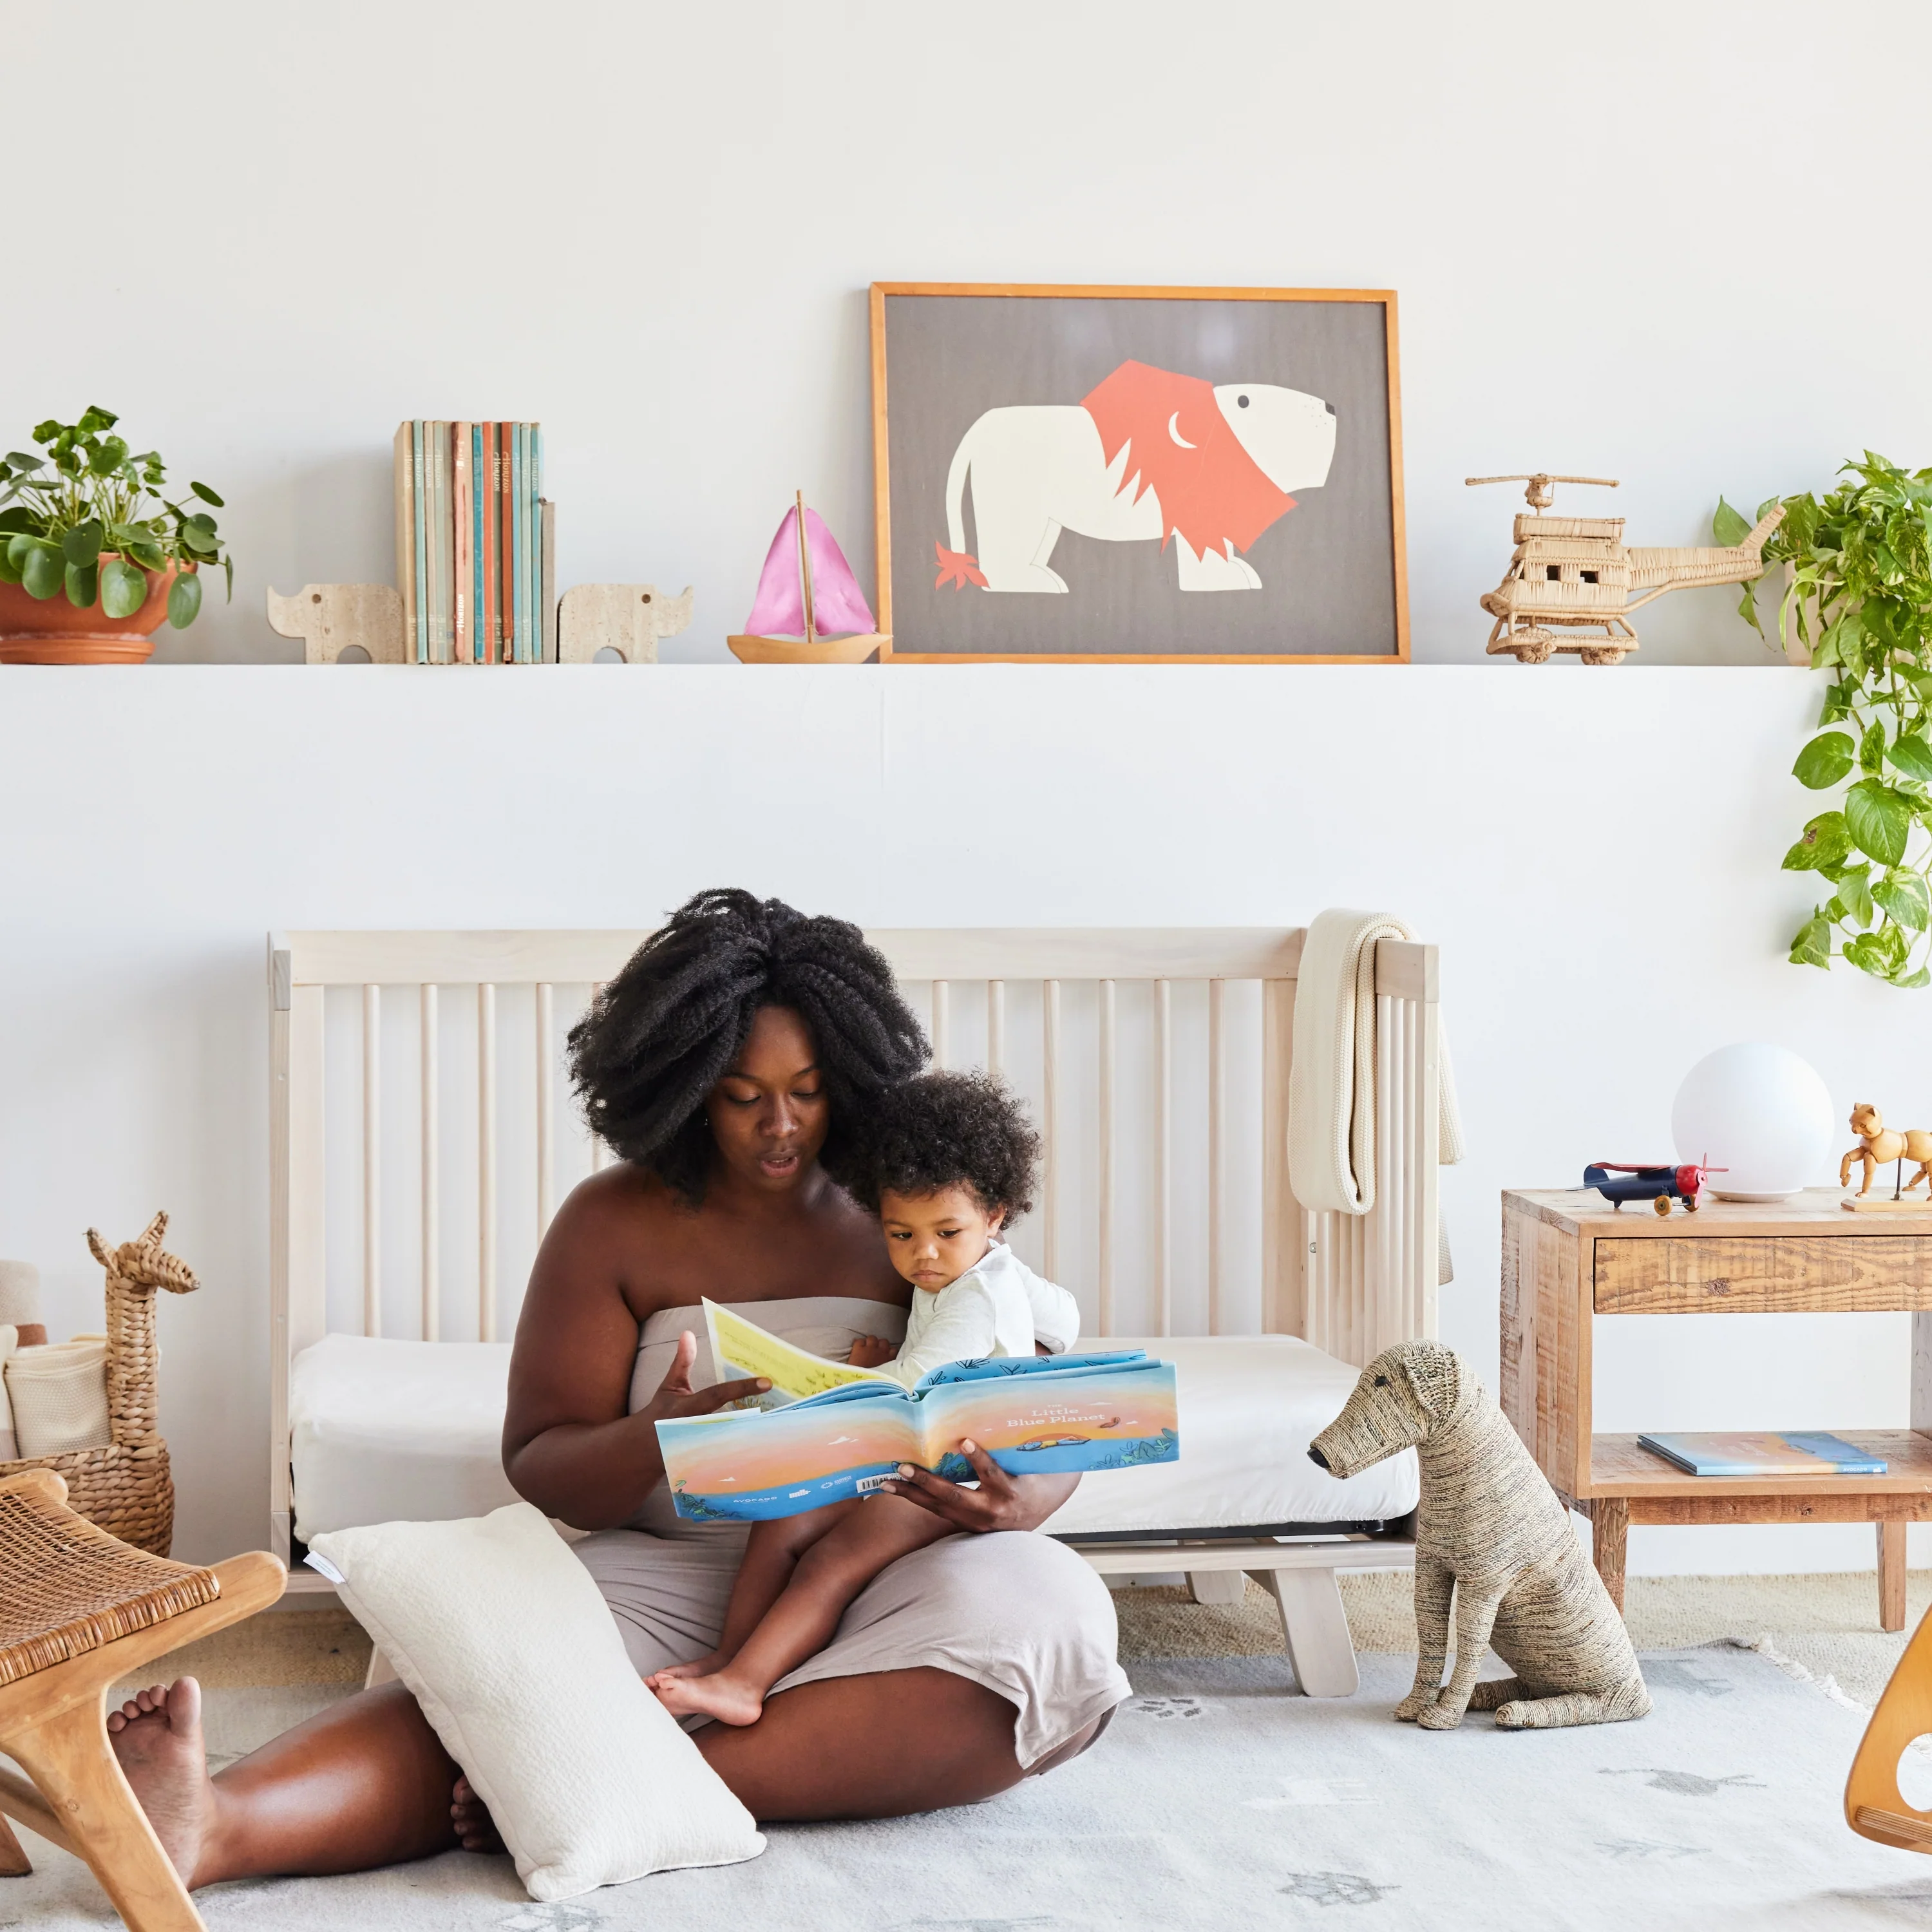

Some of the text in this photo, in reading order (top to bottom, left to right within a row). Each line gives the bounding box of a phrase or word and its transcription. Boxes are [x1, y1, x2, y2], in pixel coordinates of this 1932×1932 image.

[502, 451, 511, 494] HORIZON
[456, 593, 464, 634] HORIZON
[1007, 1414, 1106, 1427] Blue Planet
[1031, 1408, 1079, 1417] Little
